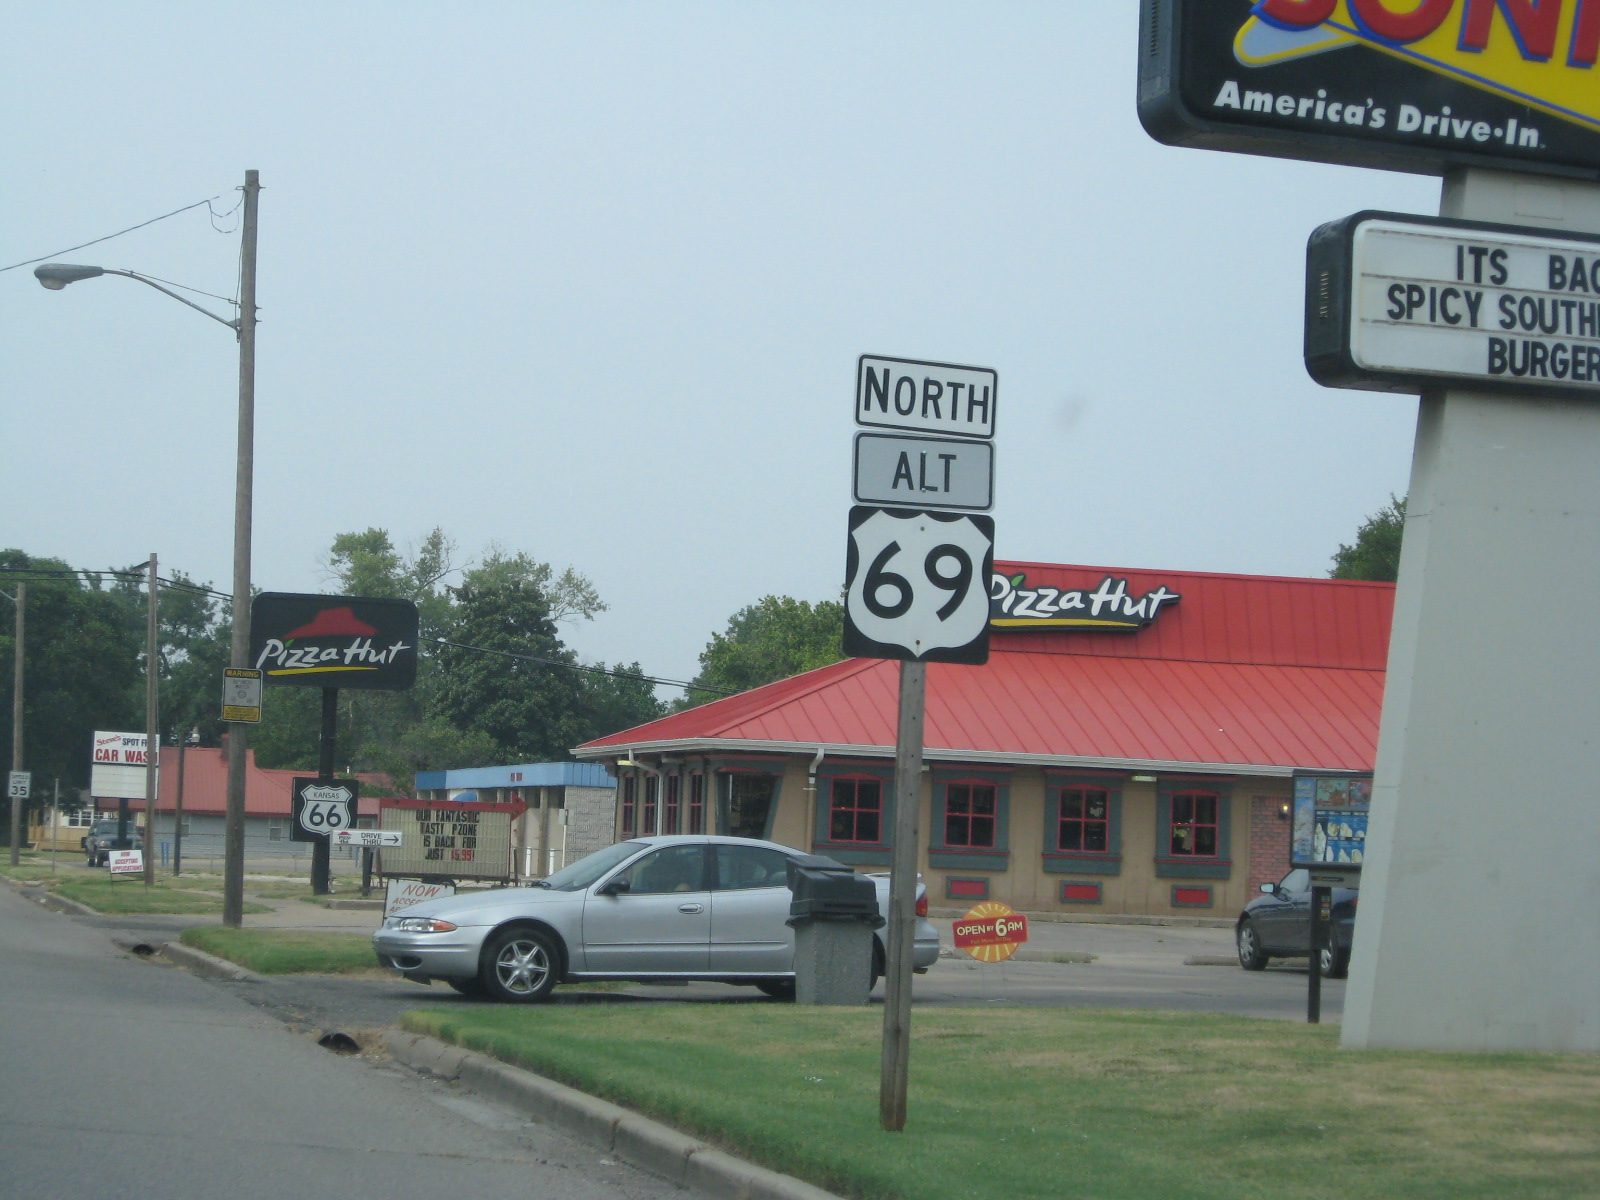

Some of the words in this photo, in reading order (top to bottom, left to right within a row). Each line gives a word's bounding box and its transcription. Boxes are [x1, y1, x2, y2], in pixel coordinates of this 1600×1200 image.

[1214, 80, 1387, 129] America's
[1457, 245, 1509, 286] ITS
[1387, 284, 1483, 327] SPICY
[1499, 294, 1600, 337] SOUTH
[864, 366, 990, 424] NORTH
[892, 451, 957, 492] ALT
[863, 540, 973, 623] 69
[991, 574, 1085, 618] Pizza
[1089, 577, 1179, 619] Hut
[256, 638, 340, 669] Pizza
[344, 637, 411, 665] Hut
[95, 749, 118, 761] CAR
[125, 750, 158, 763] WAS
[122, 738, 139, 746] SPOT
[11, 786, 27, 796] 35
[313, 791, 340, 800] KANSAS
[309, 803, 342, 828] 66
[361, 838, 382, 846] THRU
[402, 884, 441, 897] NOW
[957, 924, 985, 936] OPEN
[995, 918, 1008, 937] 6
[1007, 921, 1023, 932] AM
